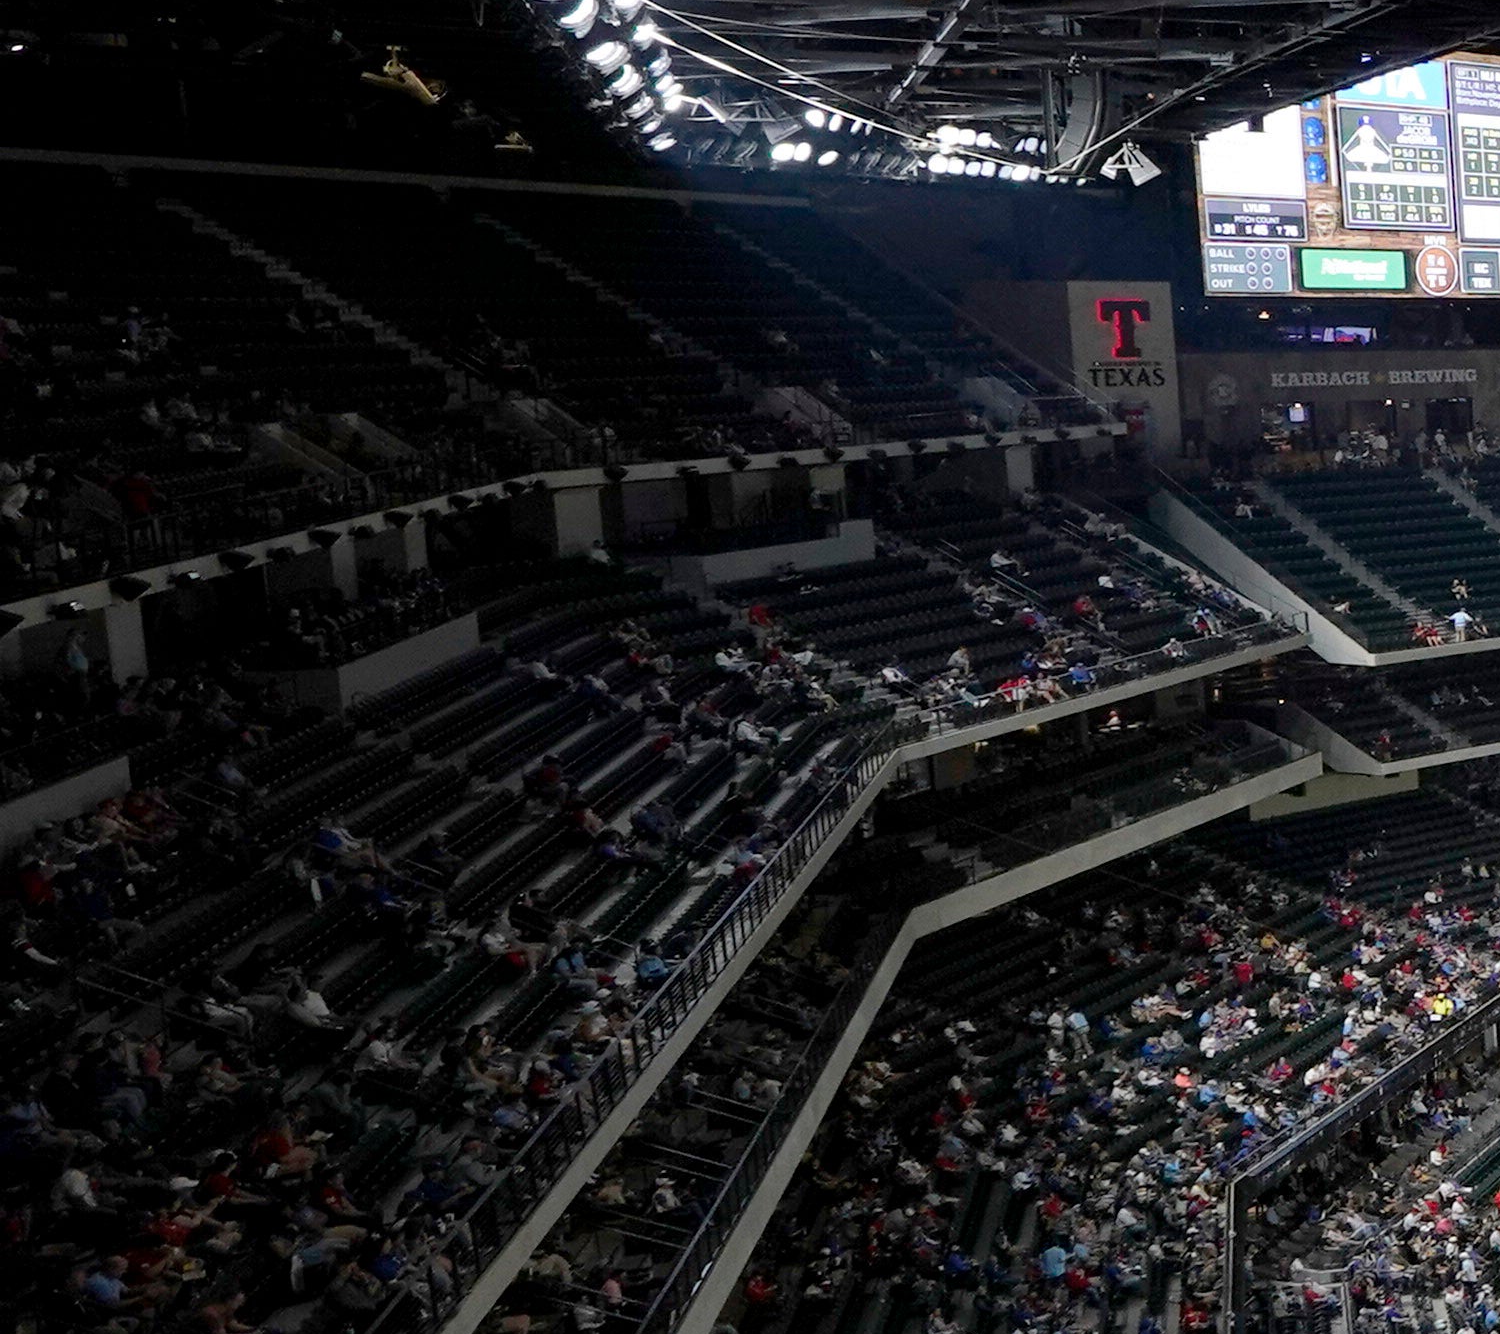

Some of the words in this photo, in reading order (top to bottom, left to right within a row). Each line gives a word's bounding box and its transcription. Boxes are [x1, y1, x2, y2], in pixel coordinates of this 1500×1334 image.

[1097, 299, 1151, 359] T
[1088, 369, 1165, 388] TEXAS
[1271, 370, 1370, 388] KARBACH
[1389, 368, 1477, 385] BREWING
